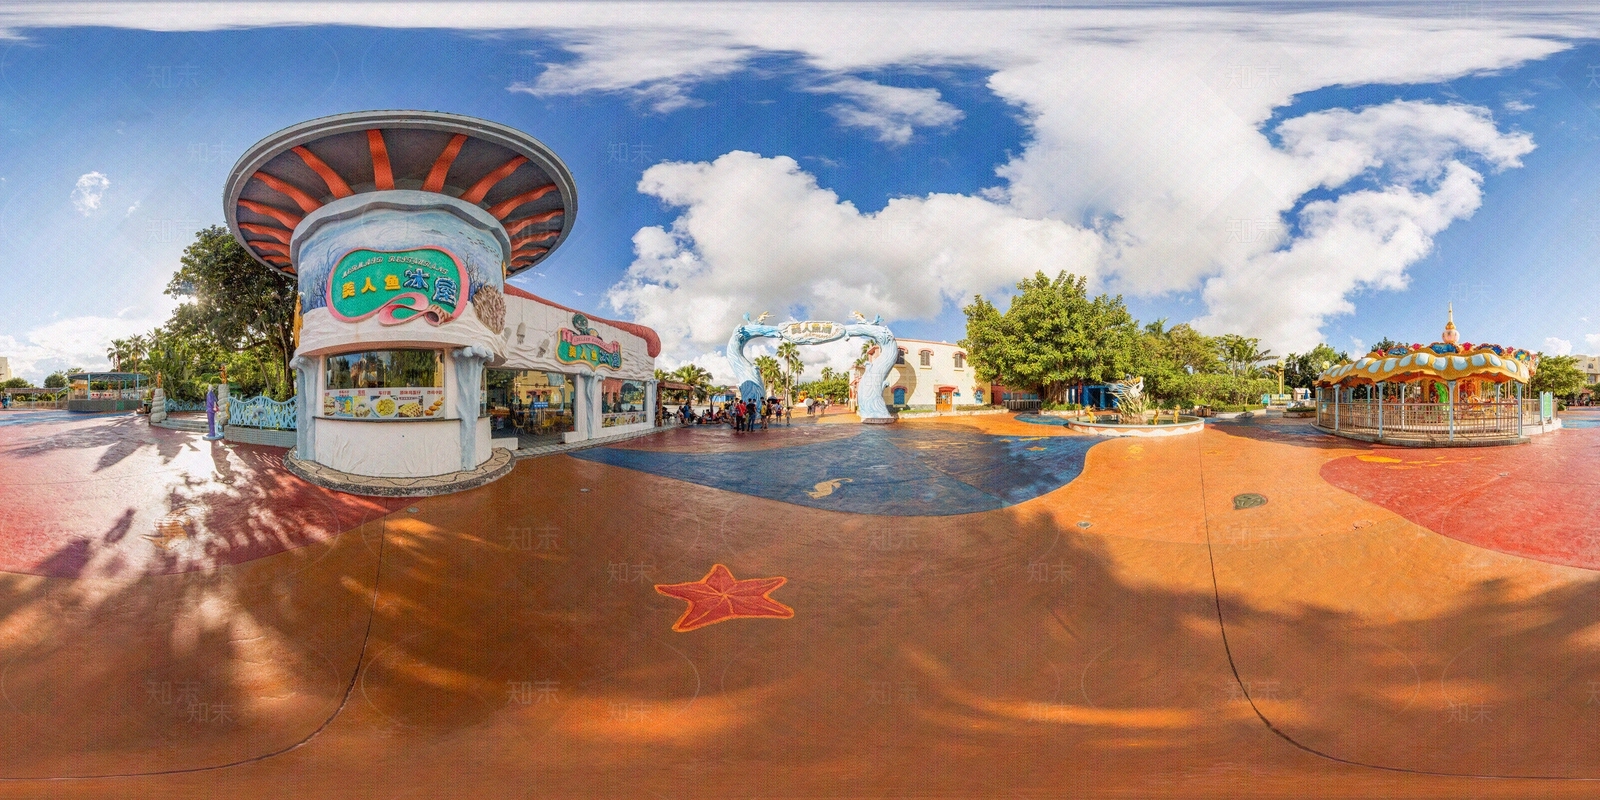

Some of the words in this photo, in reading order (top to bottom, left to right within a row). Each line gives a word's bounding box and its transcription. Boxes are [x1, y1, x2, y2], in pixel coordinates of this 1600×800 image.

[342, 268, 457, 308] 美人鱼冰屋
[568, 345, 620, 368] 美人鱼冰屋
